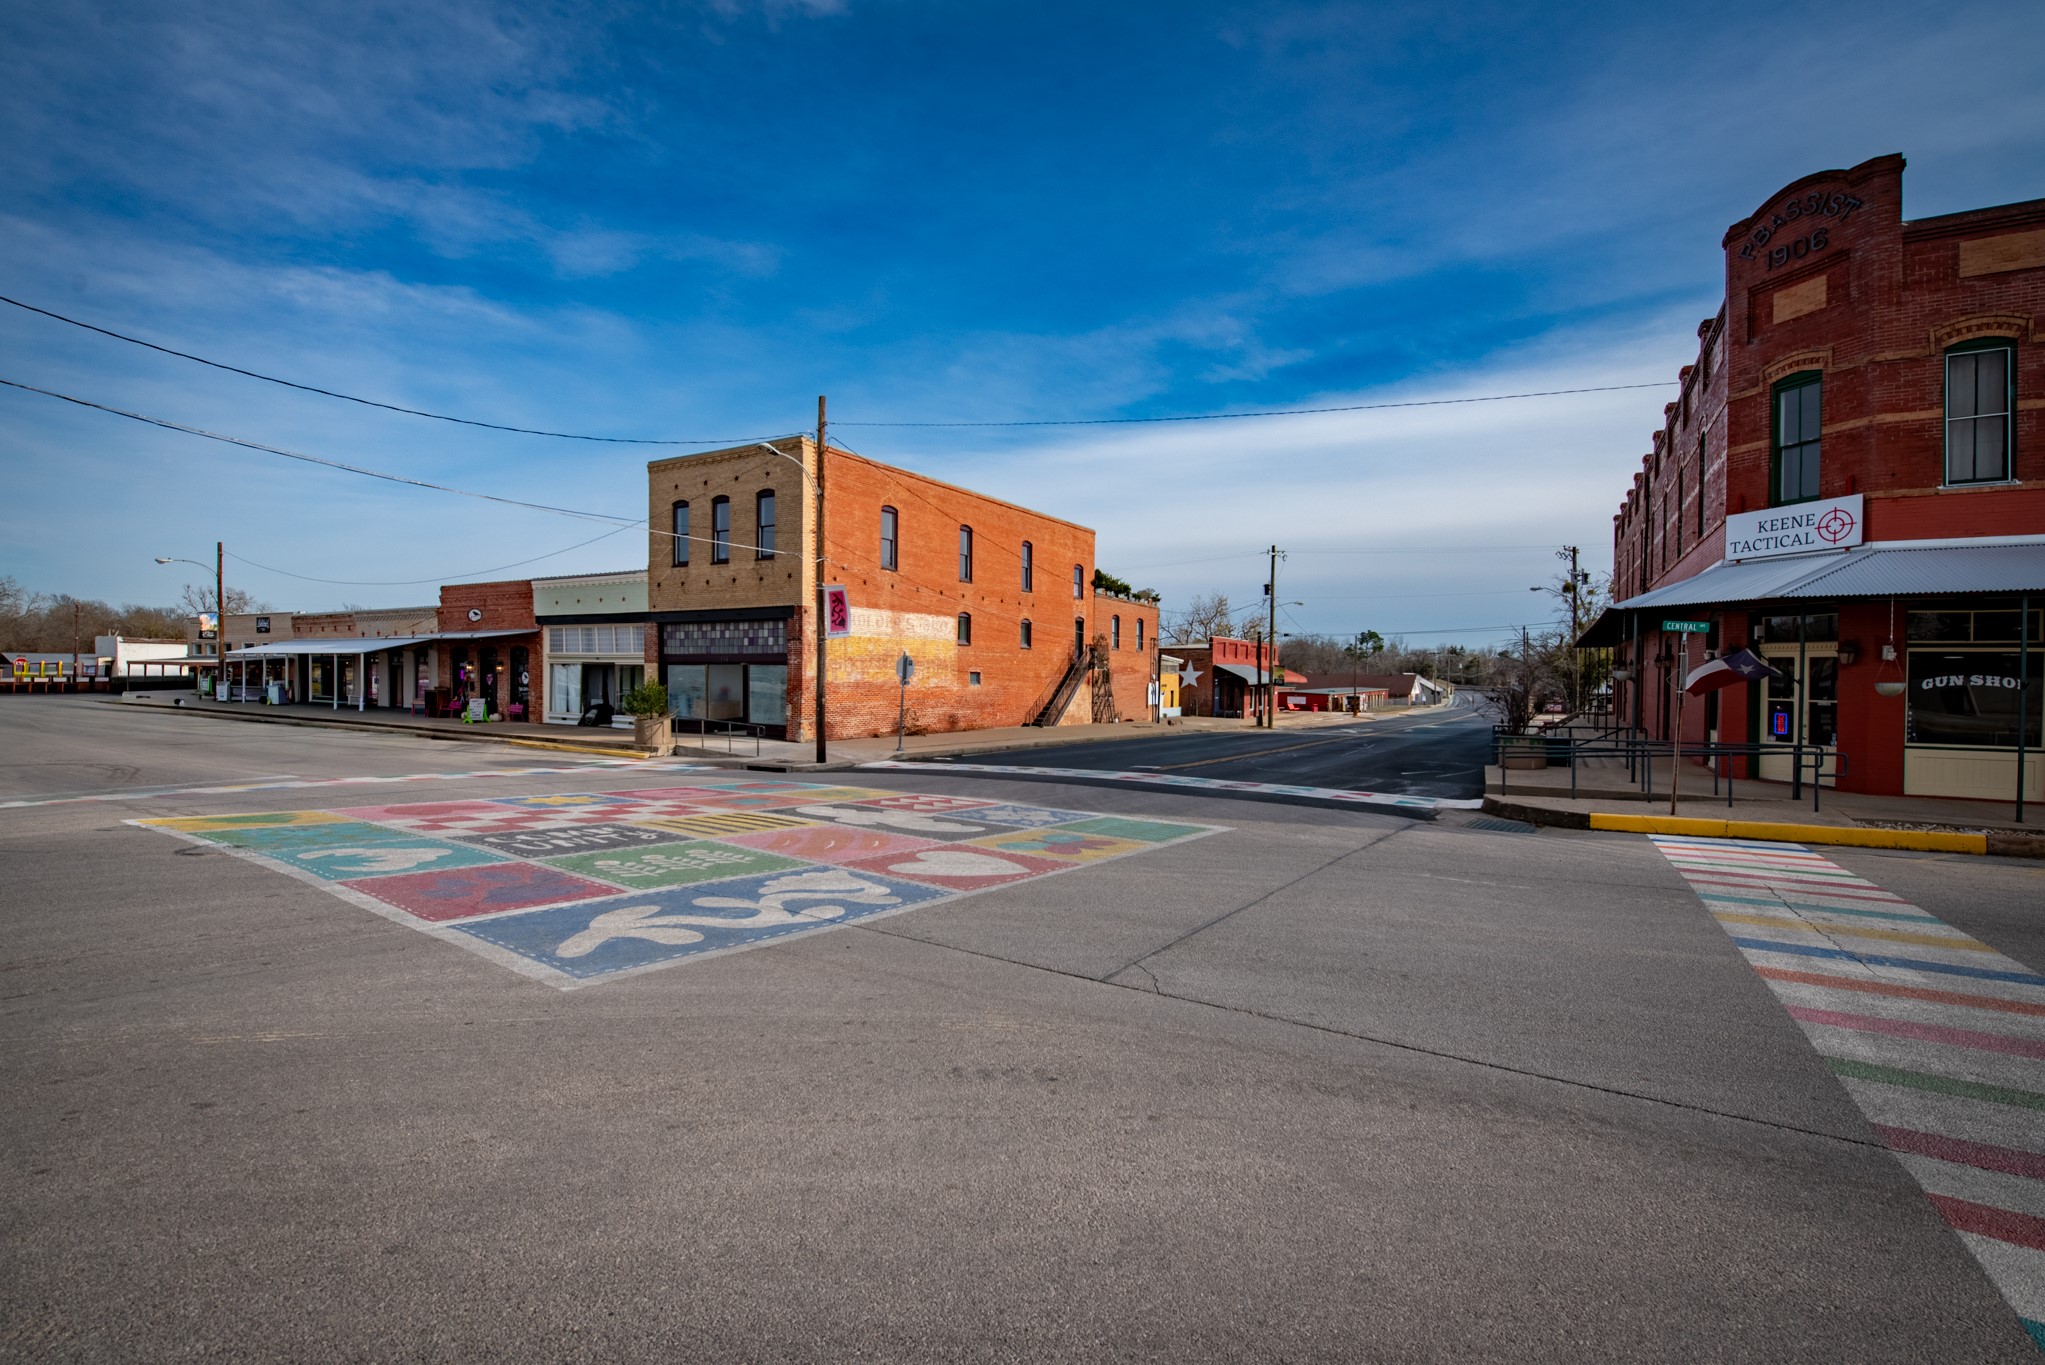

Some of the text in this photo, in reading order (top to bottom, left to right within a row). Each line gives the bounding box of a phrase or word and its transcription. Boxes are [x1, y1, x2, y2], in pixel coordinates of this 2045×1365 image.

[1752, 192, 1862, 247] BASSIST
[1766, 227, 1828, 271] 1906
[1758, 513, 1815, 533] KEENE
[1730, 532, 1815, 554] TACTICAL
[1666, 622, 1697, 631] CENTRAL
[1921, 675, 1964, 690] GUN
